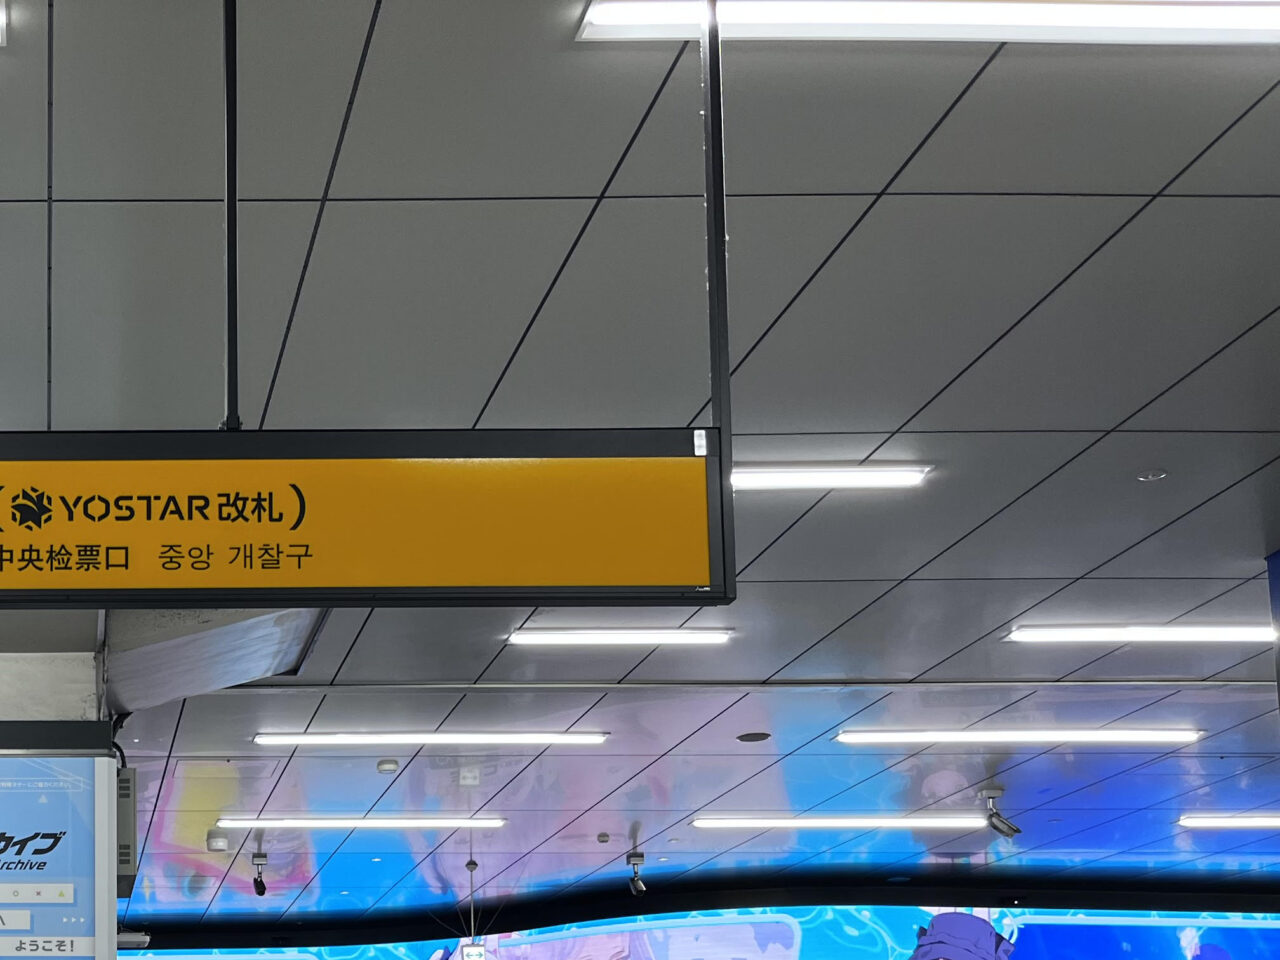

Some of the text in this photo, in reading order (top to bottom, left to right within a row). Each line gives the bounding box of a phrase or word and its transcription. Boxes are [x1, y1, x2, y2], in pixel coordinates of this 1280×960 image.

[158, 544, 315, 570] 중앙 개찰구
[14, 940, 75, 953] ようこそ!
